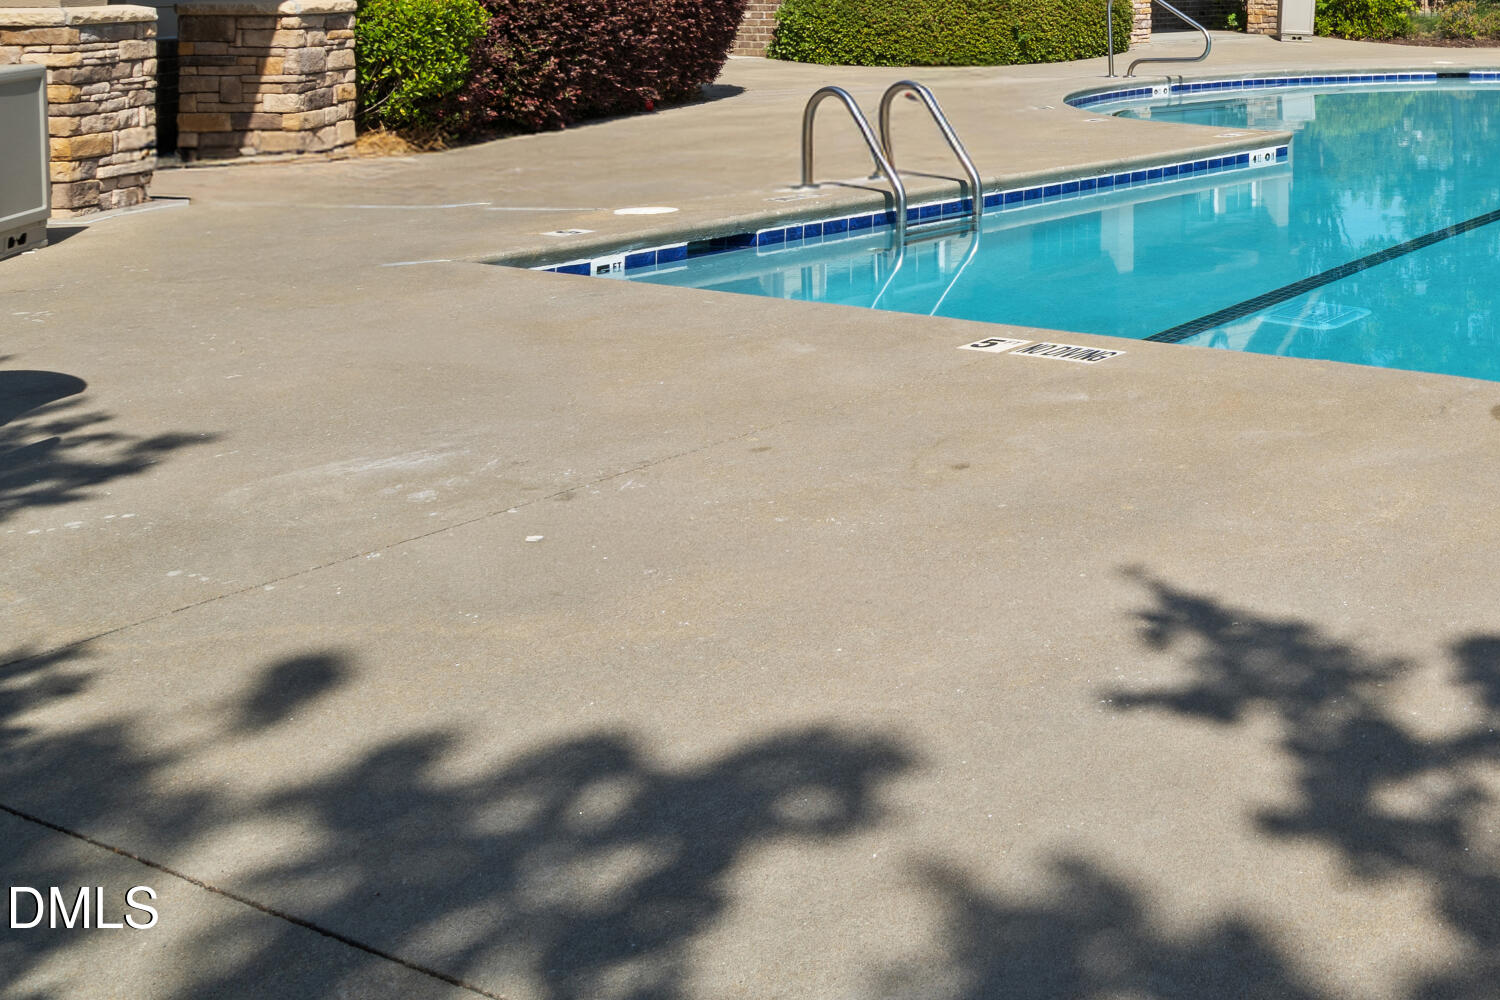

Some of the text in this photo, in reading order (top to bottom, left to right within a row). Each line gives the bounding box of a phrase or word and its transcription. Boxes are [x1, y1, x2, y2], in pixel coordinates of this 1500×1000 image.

[971, 338, 1007, 349] 5
[1015, 343, 1117, 362] NO DIVING
